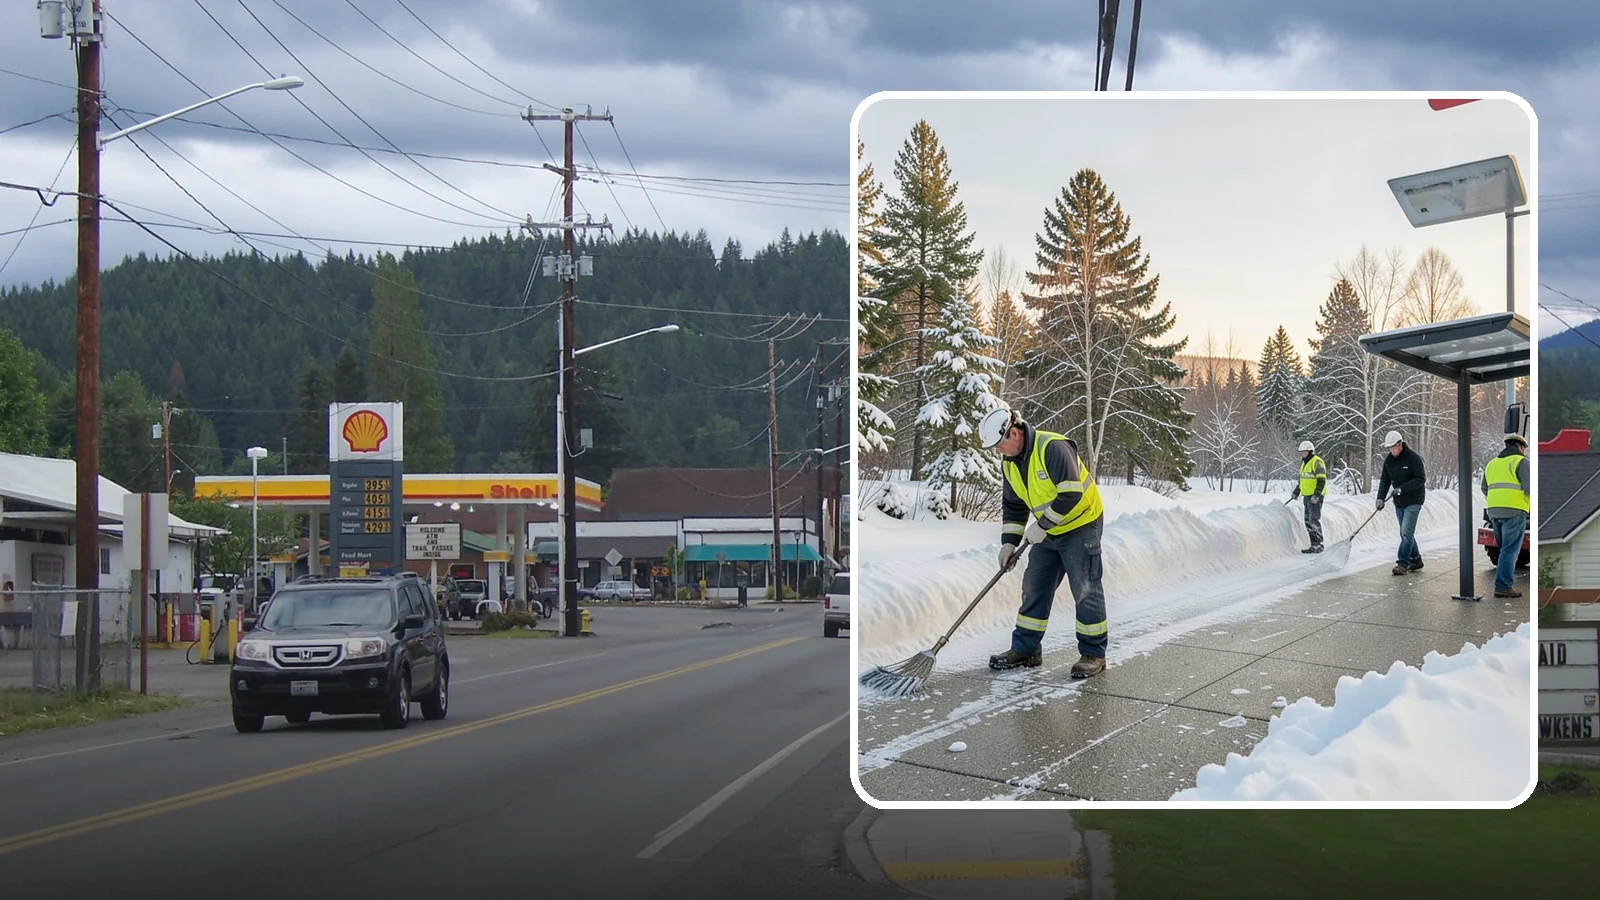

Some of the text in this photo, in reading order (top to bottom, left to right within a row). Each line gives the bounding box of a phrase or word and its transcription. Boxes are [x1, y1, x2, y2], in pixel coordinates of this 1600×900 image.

[366, 480, 383, 490] 395
[490, 484, 547, 499] Shell
[366, 494, 383, 504] 405
[366, 508, 383, 518] 415
[366, 522, 383, 532] 429
[1538, 643, 1567, 666] AID
